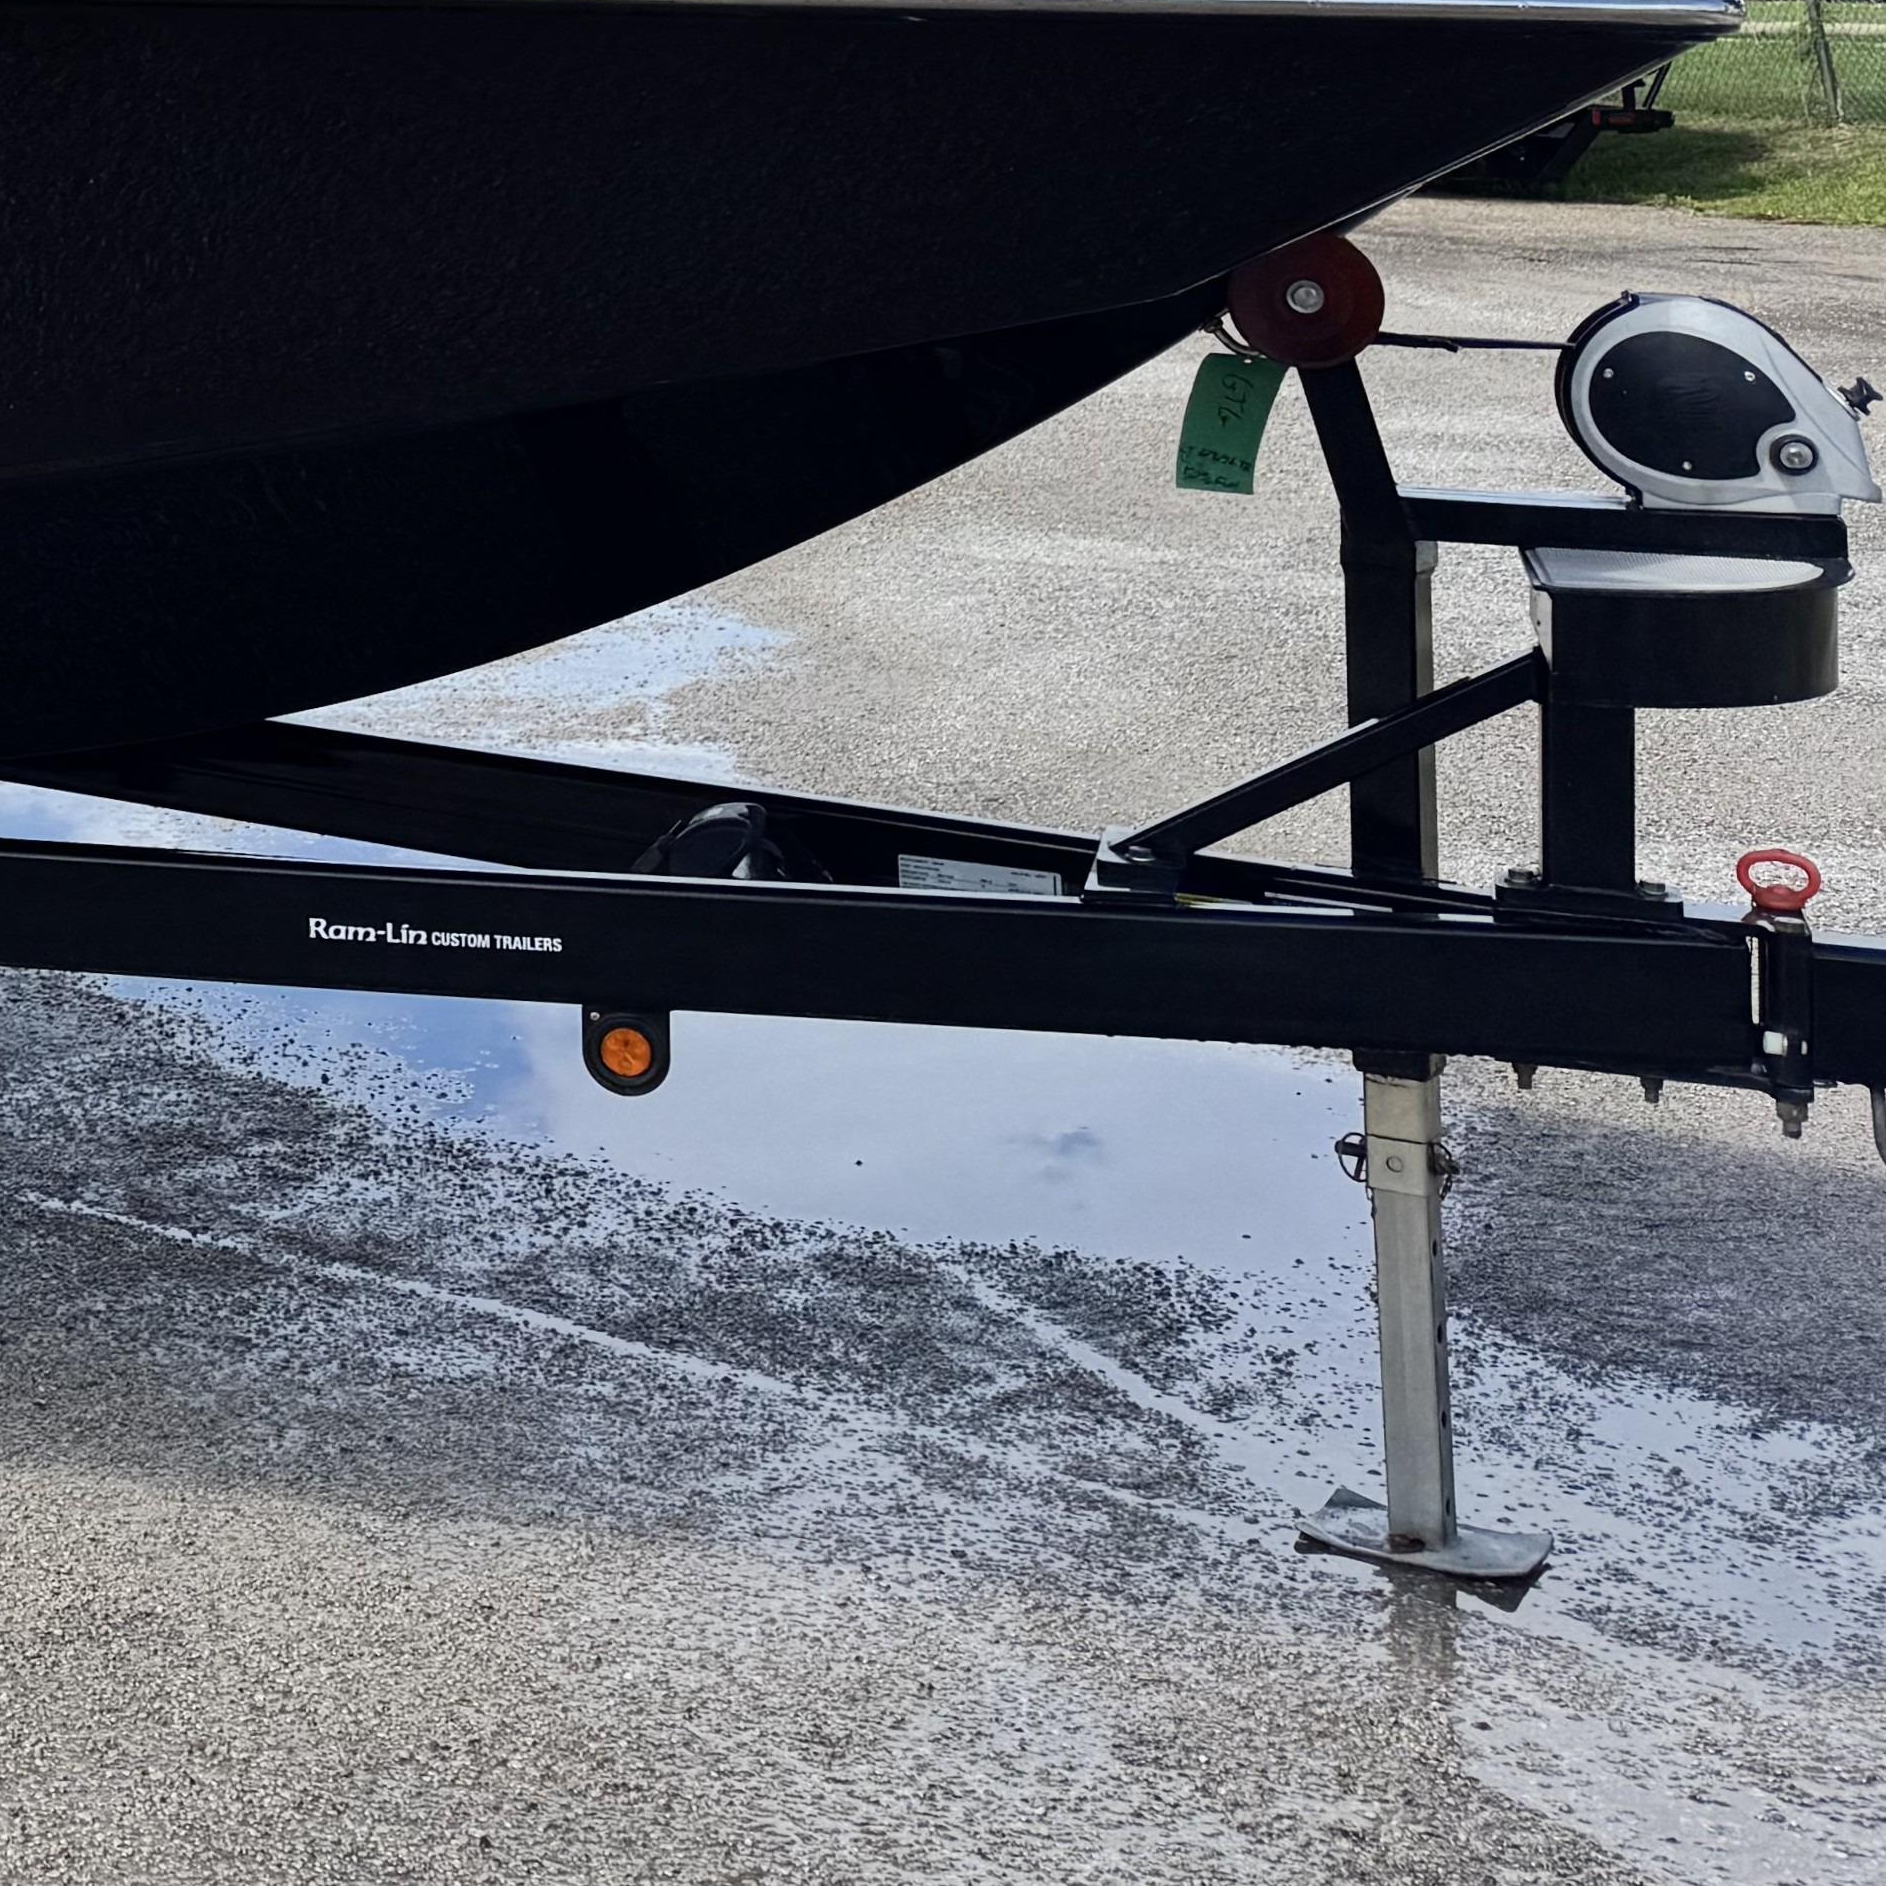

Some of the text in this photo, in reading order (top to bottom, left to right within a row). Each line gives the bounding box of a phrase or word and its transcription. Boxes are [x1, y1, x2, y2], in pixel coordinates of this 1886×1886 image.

[309, 917, 562, 952] Ram-Lin CUSTOM TRAILERS
